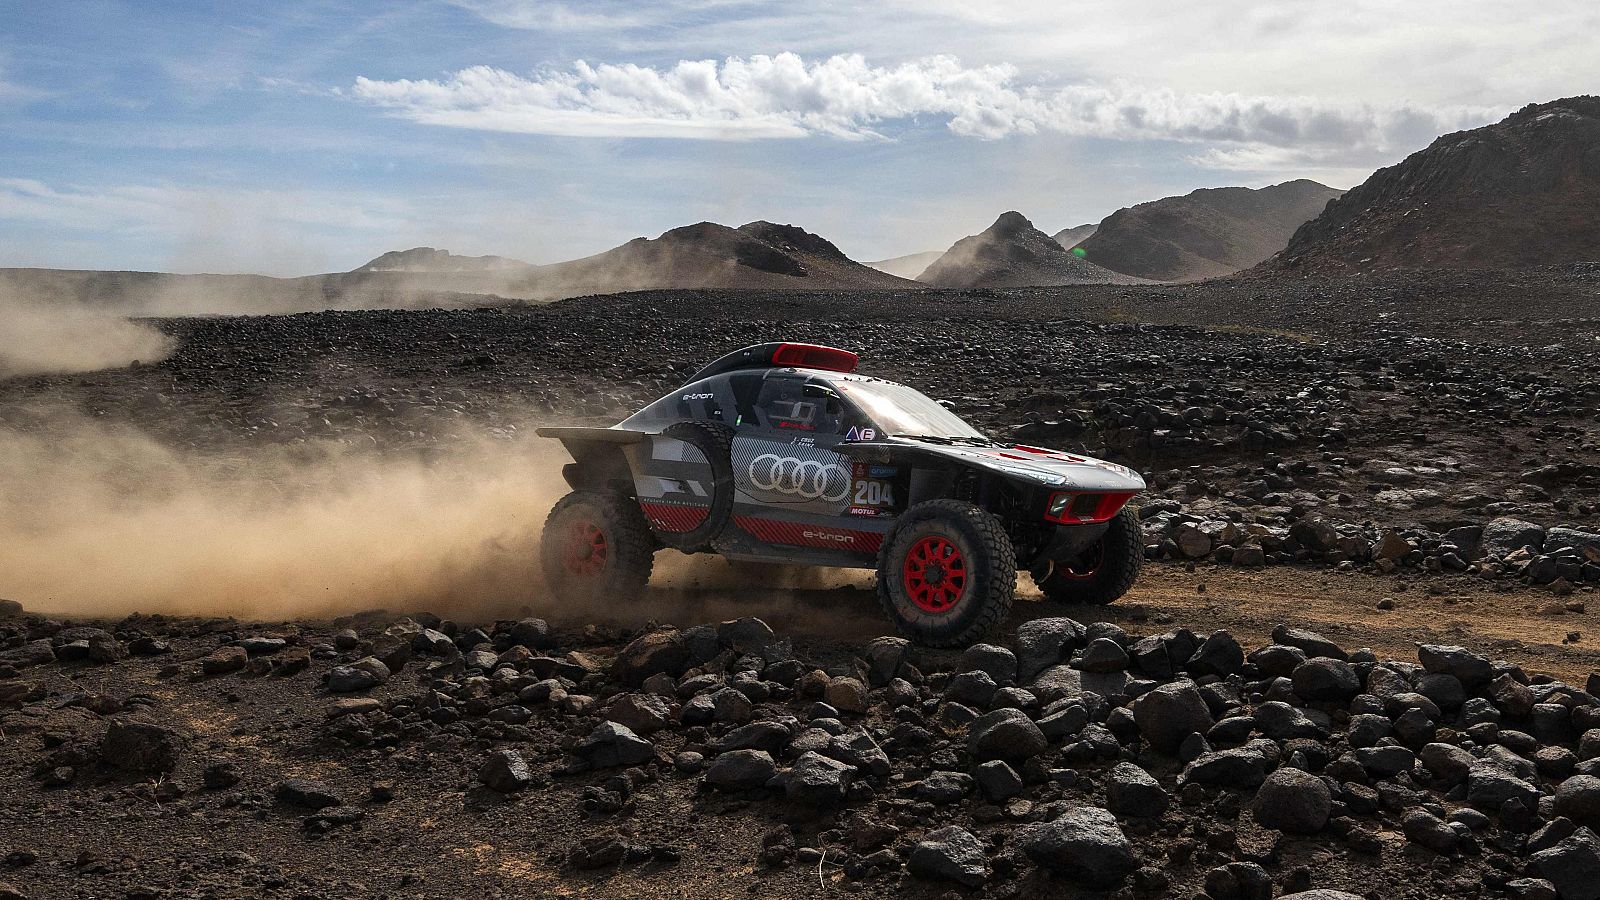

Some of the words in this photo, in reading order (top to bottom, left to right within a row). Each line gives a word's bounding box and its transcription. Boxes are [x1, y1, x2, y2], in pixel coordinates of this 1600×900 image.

[863, 429, 873, 440] E
[855, 480, 896, 507] 204
[803, 531, 854, 543] e-tron
